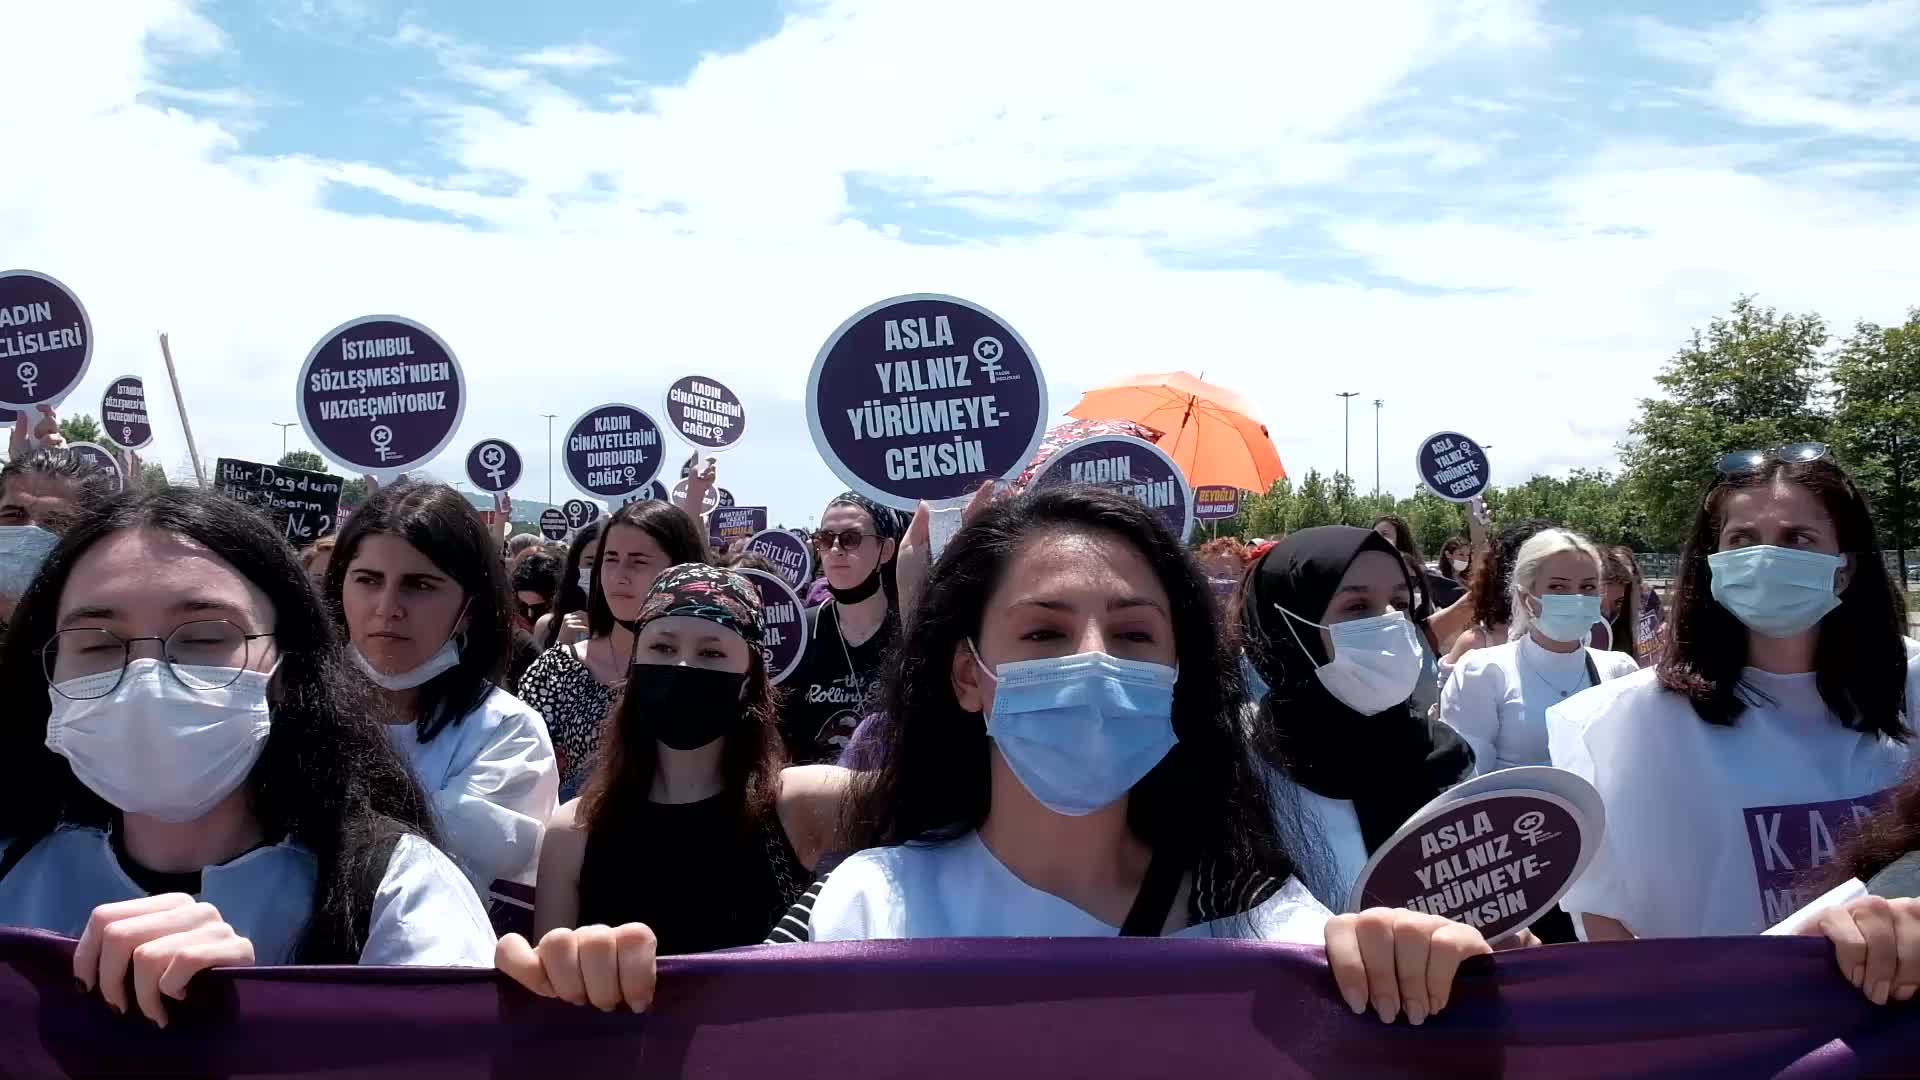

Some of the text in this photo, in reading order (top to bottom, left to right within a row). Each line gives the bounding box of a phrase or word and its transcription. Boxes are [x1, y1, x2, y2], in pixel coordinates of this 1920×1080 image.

[0, 301, 52, 328] ADIN
[0, 321, 82, 358] CLİSLERİ
[884, 315, 954, 351] ASLA
[341, 336, 415, 361] İSTANBUL
[310, 361, 451, 394] SÖZLEŞMESİ'NDEN
[875, 355, 972, 394] YALNIZ
[670, 388, 741, 418] CİNAYETLERİNİ
[691, 380, 721, 400] KADIN
[319, 390, 447, 422] VAZGEÇMİYORUZ
[683, 405, 734, 428] DURDURA-
[847, 395, 1010, 441] YÜRÜMEYE-
[594, 415, 631, 432] KADIN
[682, 421, 713, 439] CAĞIZ
[570, 427, 657, 452] CİNAYETLERİNİ
[1431, 438, 1455, 455] ASLA
[223, 463, 253, 481] Hür
[586, 448, 649, 468] DURDURA-
[885, 435, 986, 481] CEKSİN
[1070, 455, 1132, 484] KADIN
[1433, 449, 1466, 469] YALNIZ
[587, 467, 623, 487] CAĞIZ
[1449, 474, 1481, 495] CEKSİN
[285, 512, 312, 538] Ne
[317, 514, 331, 537] ?
[805, 684, 868, 713] Rolling
[1420, 811, 1494, 859] ASLA
[1415, 834, 1513, 890] YALNIZ
[1406, 854, 1552, 915] ÜRÜMEYE-
[1449, 889, 1529, 929] KSİN
